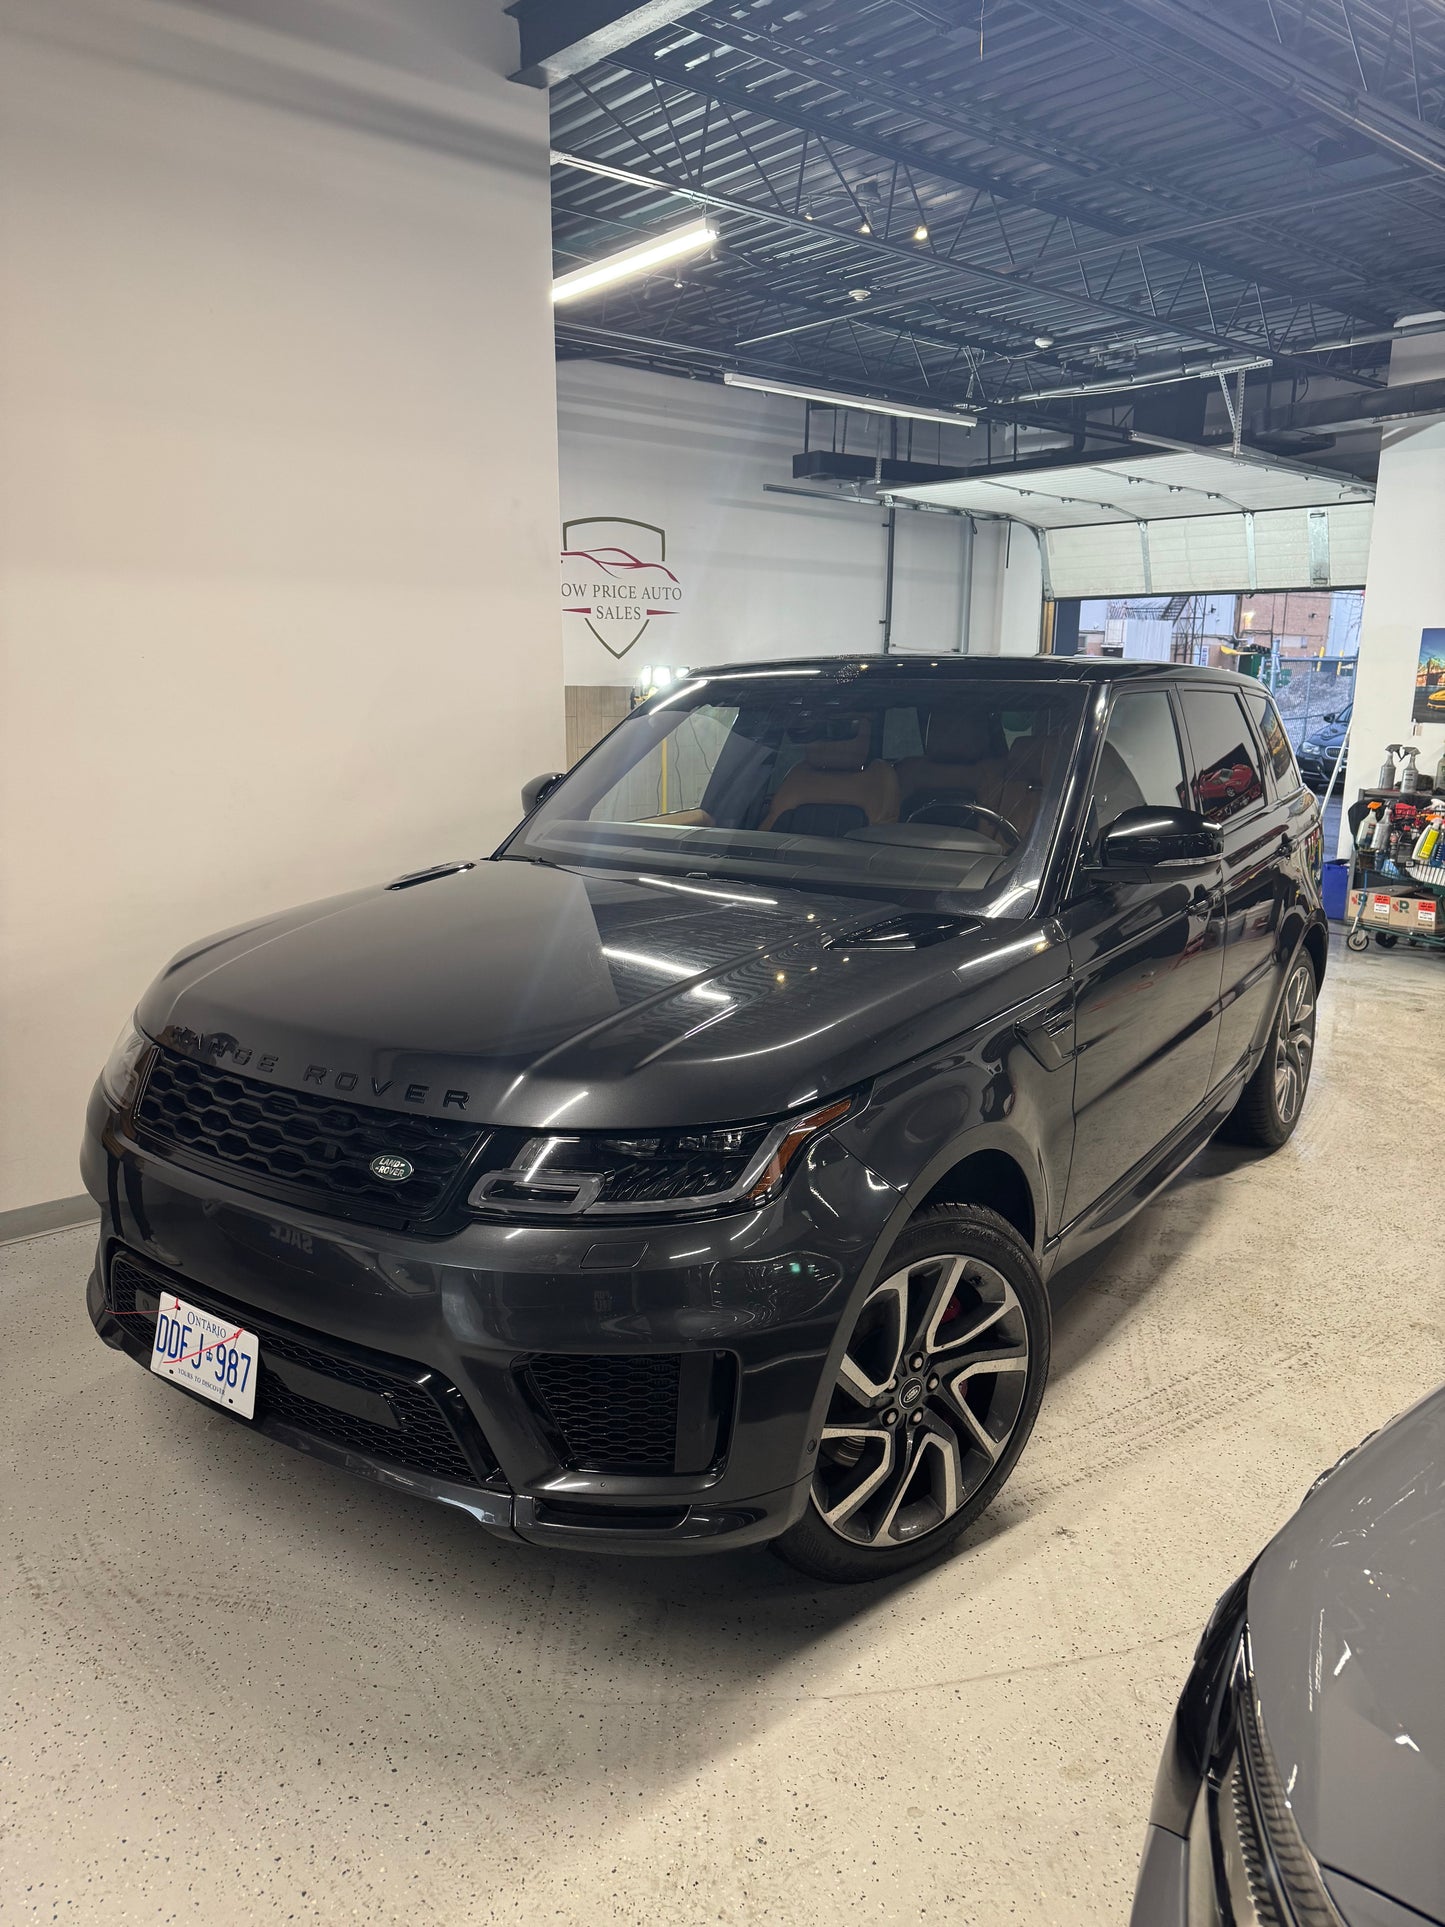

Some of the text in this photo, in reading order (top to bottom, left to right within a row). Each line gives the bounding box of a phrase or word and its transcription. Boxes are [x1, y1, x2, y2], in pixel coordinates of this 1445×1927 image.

[561, 582, 682, 601] OW PRICE AUTO
[596, 605, 641, 620] SALES
[303, 1064, 470, 1111] ROVER
[379, 1157, 401, 1168] LAND
[378, 1165, 405, 1177] ROVER
